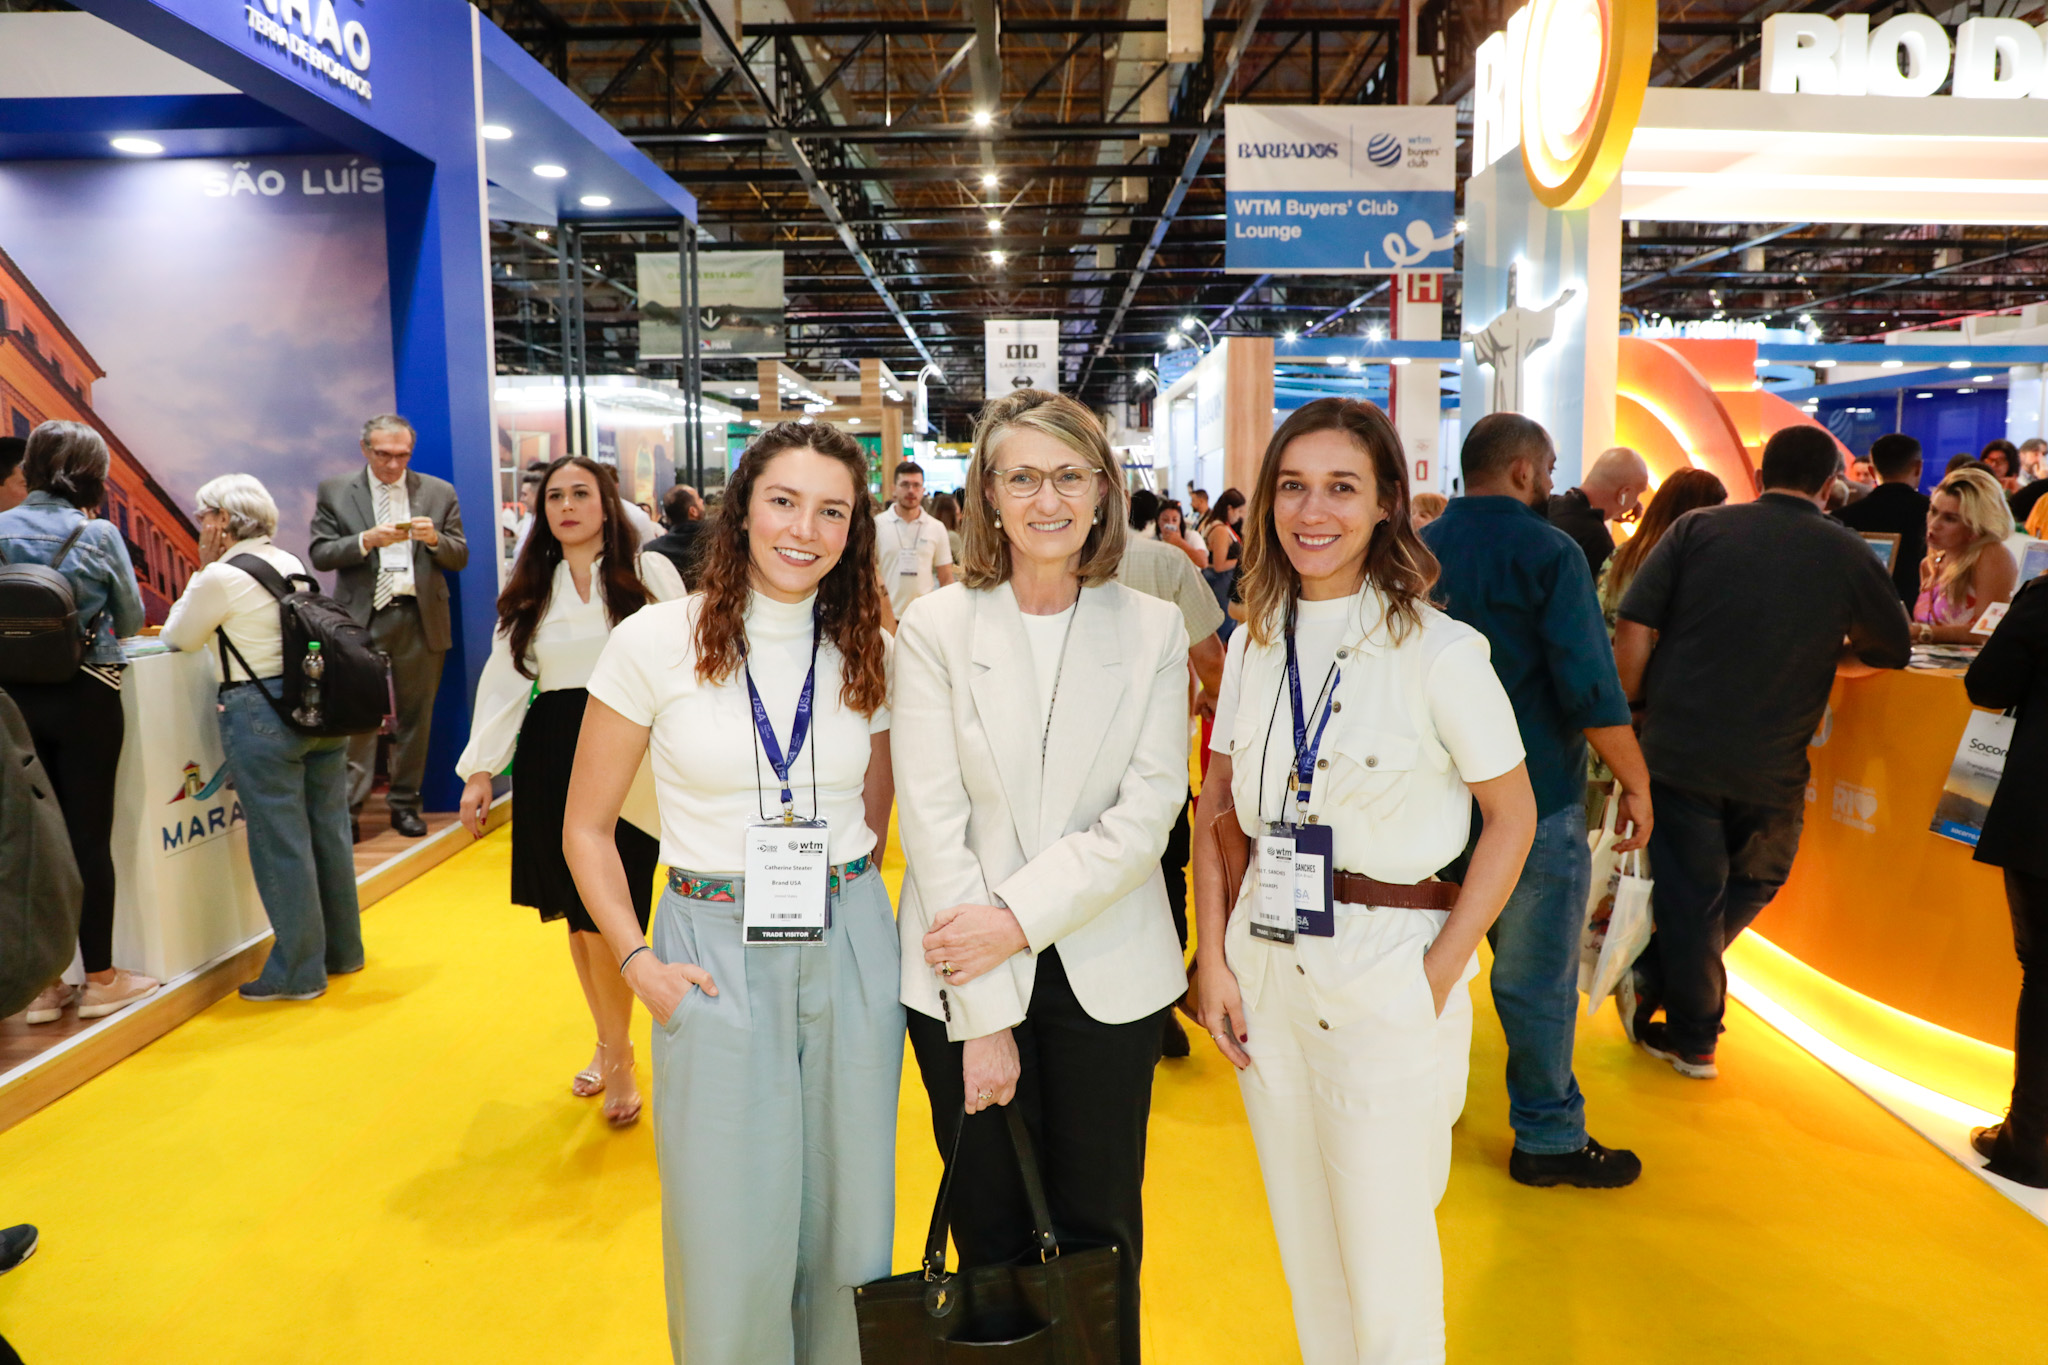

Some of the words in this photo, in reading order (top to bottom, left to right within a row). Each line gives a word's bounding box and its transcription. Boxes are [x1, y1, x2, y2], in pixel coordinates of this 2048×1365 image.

[1760, 12, 1951, 97] RIO
[1952, 16, 2048, 99] D
[1407, 135, 1432, 144] wtm
[1237, 142, 1339, 159] BARBADOS
[1407, 158, 1429, 168] club
[203, 160, 286, 197] SÃO
[302, 158, 384, 195] LUÍS
[1234, 199, 1281, 215] WTM
[1286, 199, 1353, 219] Buyers'
[1357, 199, 1399, 216] Club
[1235, 222, 1302, 242] Lounge
[753, 697, 766, 722] USA
[798, 689, 811, 713] USA
[774, 762, 787, 781] US
[800, 841, 823, 850] wtm
[1275, 848, 1292, 857] wtm
[1295, 862, 1316, 873] SANCHES
[1295, 888, 1310, 900] SA
[1296, 915, 1310, 926] SA
